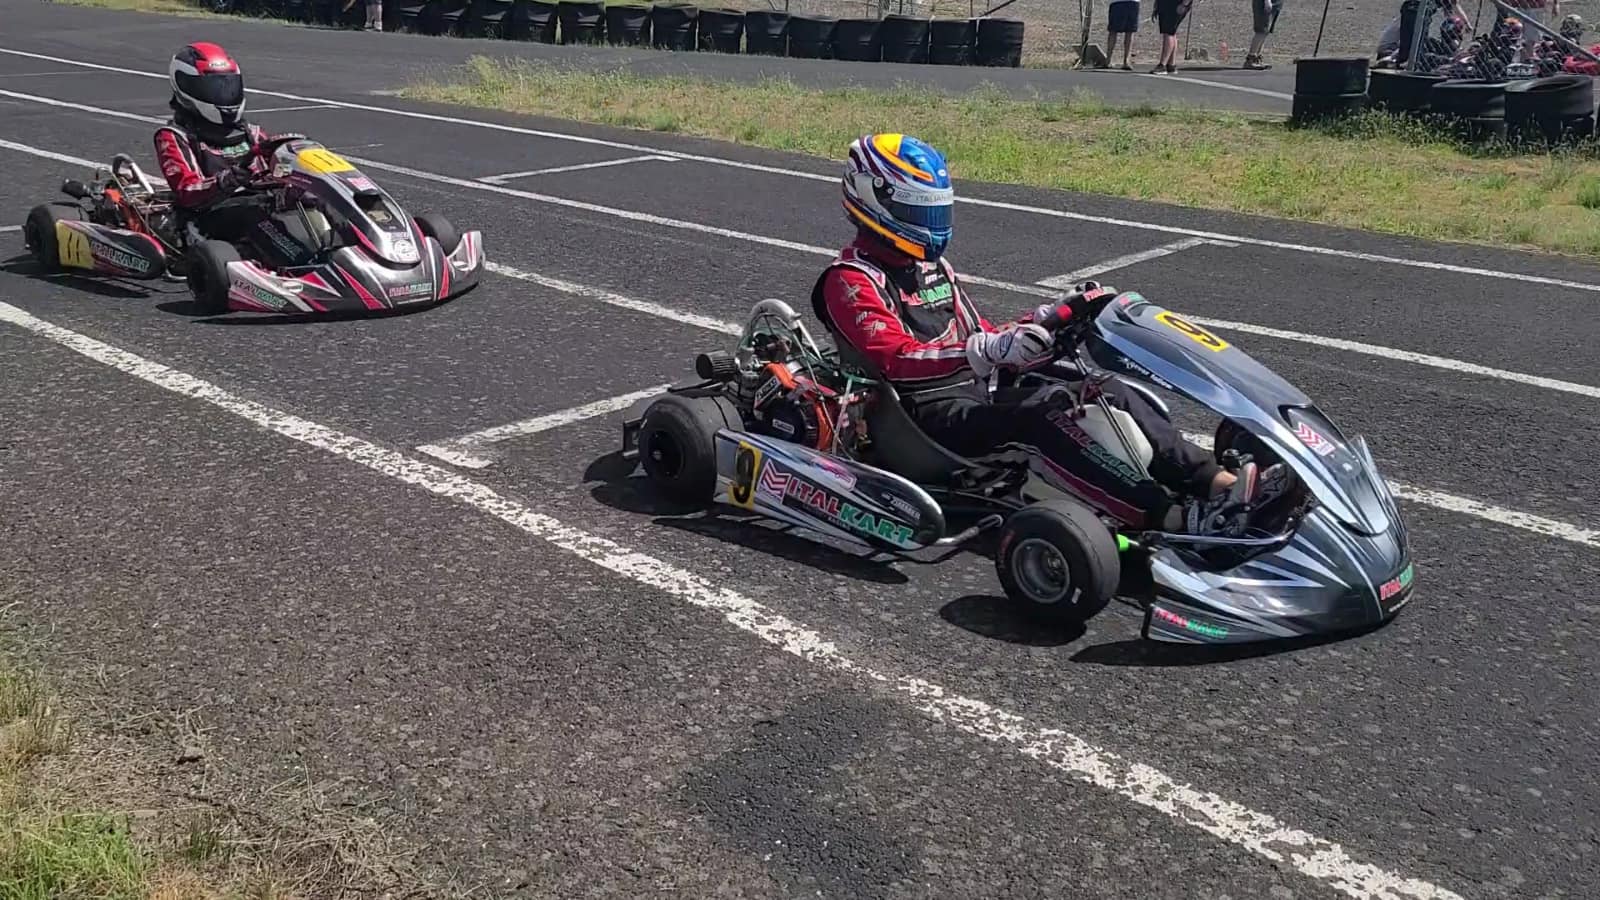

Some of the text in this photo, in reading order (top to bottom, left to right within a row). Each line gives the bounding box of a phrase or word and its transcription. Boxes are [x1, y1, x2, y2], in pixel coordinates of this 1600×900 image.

[1162, 313, 1222, 347] 9
[733, 448, 756, 505] 9
[786, 478, 914, 545] ITALKART
